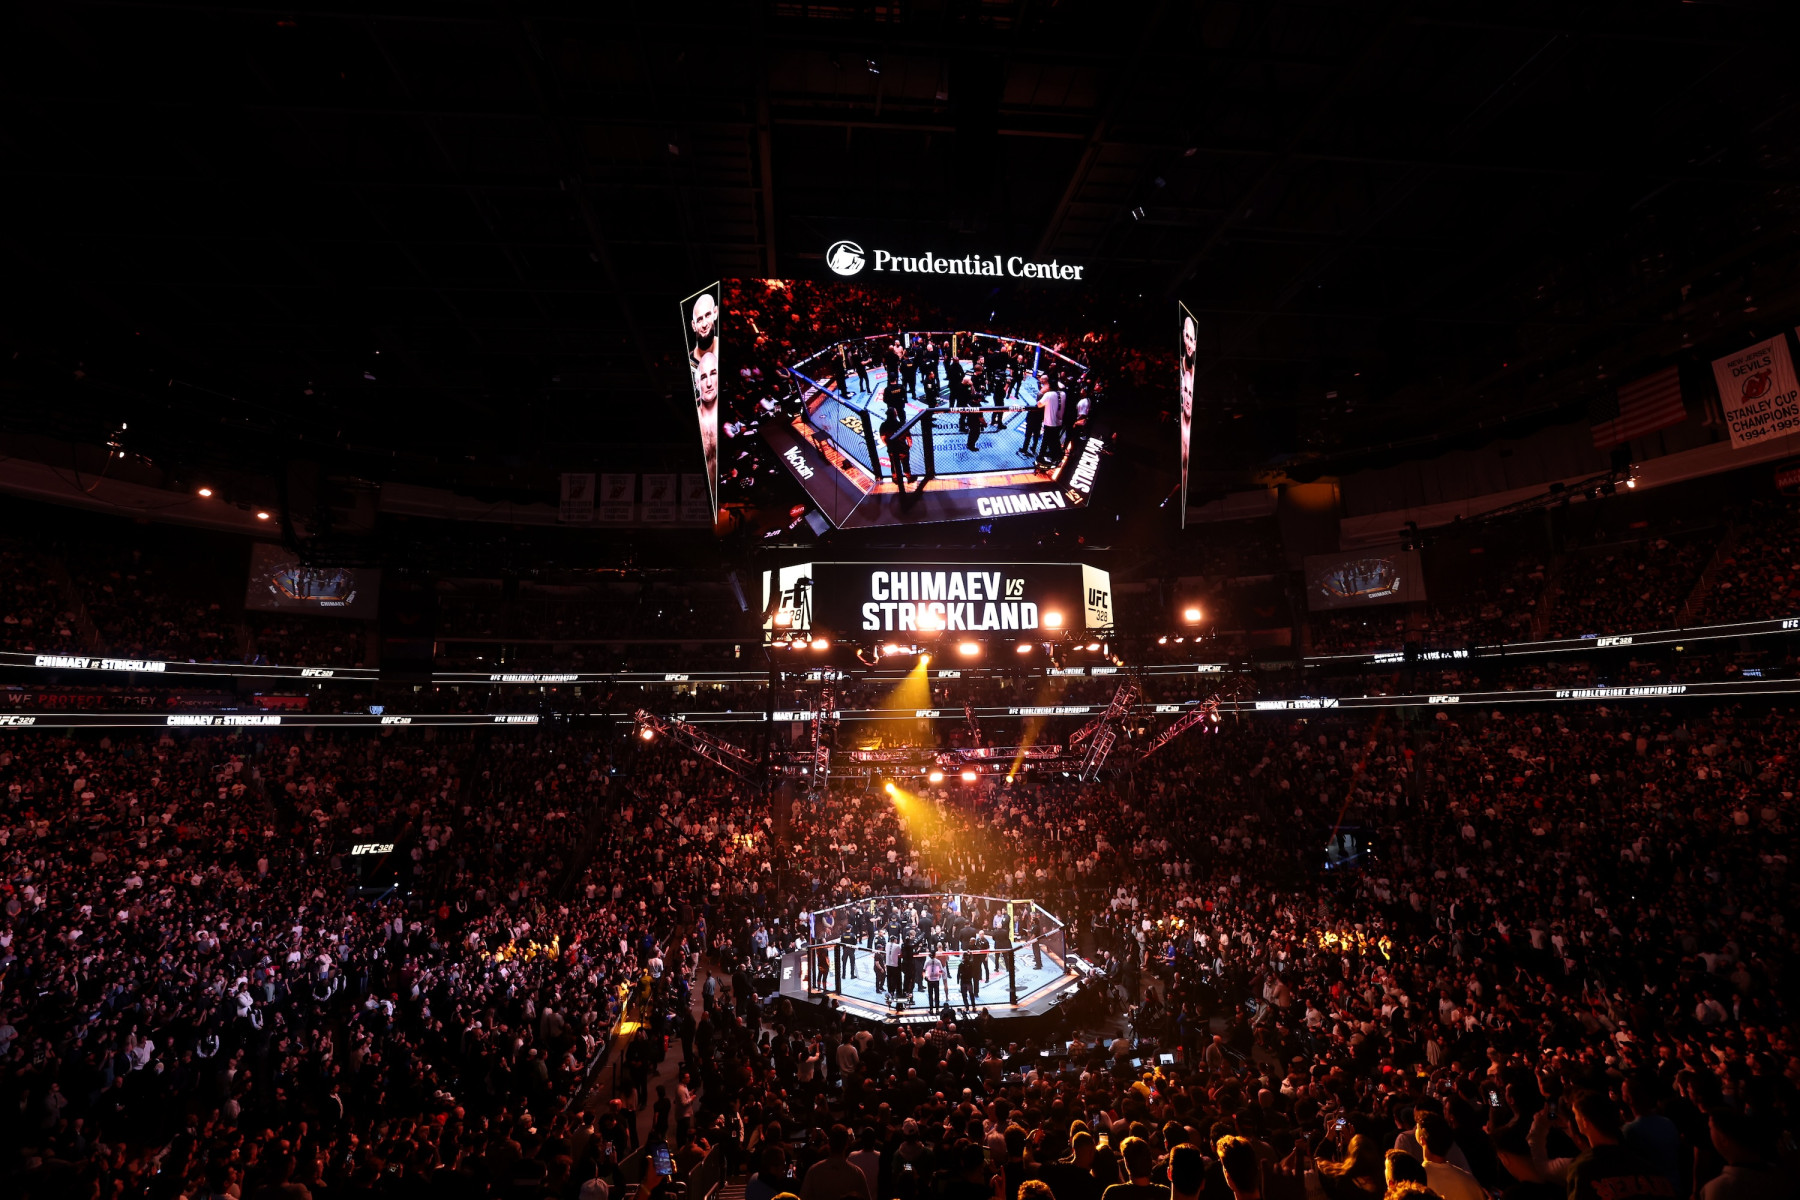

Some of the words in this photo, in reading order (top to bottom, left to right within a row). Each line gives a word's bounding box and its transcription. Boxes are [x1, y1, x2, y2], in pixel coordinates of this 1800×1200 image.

[873, 249, 1004, 276] Prudential
[1007, 256, 1084, 280] Center
[1727, 358, 1745, 368] NEW
[1746, 347, 1772, 362] JERSEY
[1732, 356, 1772, 377] DEVILS
[1726, 400, 1771, 422] STANLEY
[1774, 390, 1798, 407] CUP
[1732, 404, 1799, 433] CHAMPIONS
[1738, 419, 1800, 441] 1994-1995
[783, 445, 814, 480] VeChain
[977, 490, 1066, 516] CHIMAEV
[870, 570, 1001, 601] CHIMAEV
[1005, 579, 1024, 600] VS
[1088, 587, 1108, 609] UFC
[862, 601, 1039, 631] STRICKLAND
[1096, 609, 1108, 622] 328
[1782, 620, 1799, 629] UFC
[35, 656, 90, 668] CHIMAEV
[101, 659, 166, 672] STRICKLAND
[38, 694, 104, 704] PROTECT
[1556, 690, 1570, 698] UFC
[1572, 688, 1627, 698] MIDDLEWEIGHT
[1629, 686, 1687, 695] CHAMPIONSHIP
[167, 715, 213, 725] CHIMAEV
[223, 715, 281, 725] STRICKLAND
[351, 843, 380, 855] UFC
